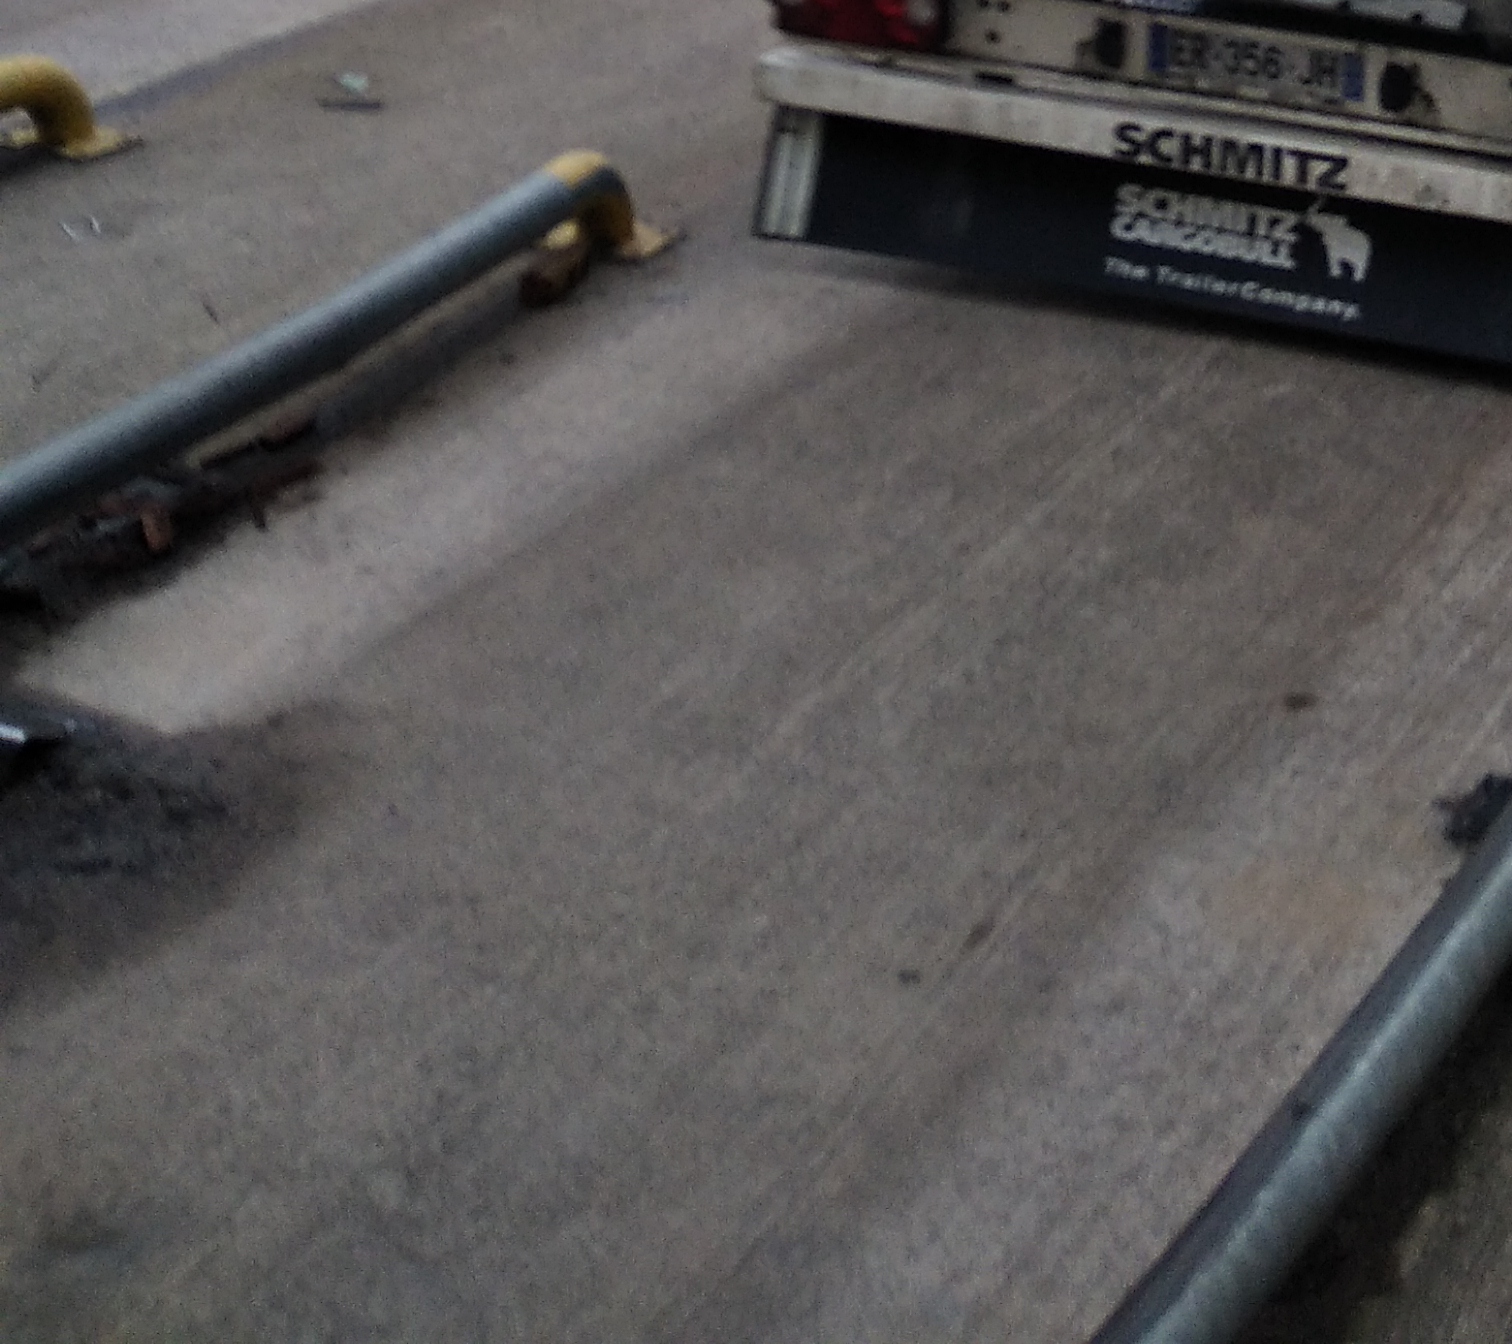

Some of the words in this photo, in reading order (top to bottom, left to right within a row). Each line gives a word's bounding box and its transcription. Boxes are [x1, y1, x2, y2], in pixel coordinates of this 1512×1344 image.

[1113, 122, 1348, 190] SCHMITZ
[1114, 183, 1298, 243] SCHMITZ
[1105, 256, 1150, 280] The
